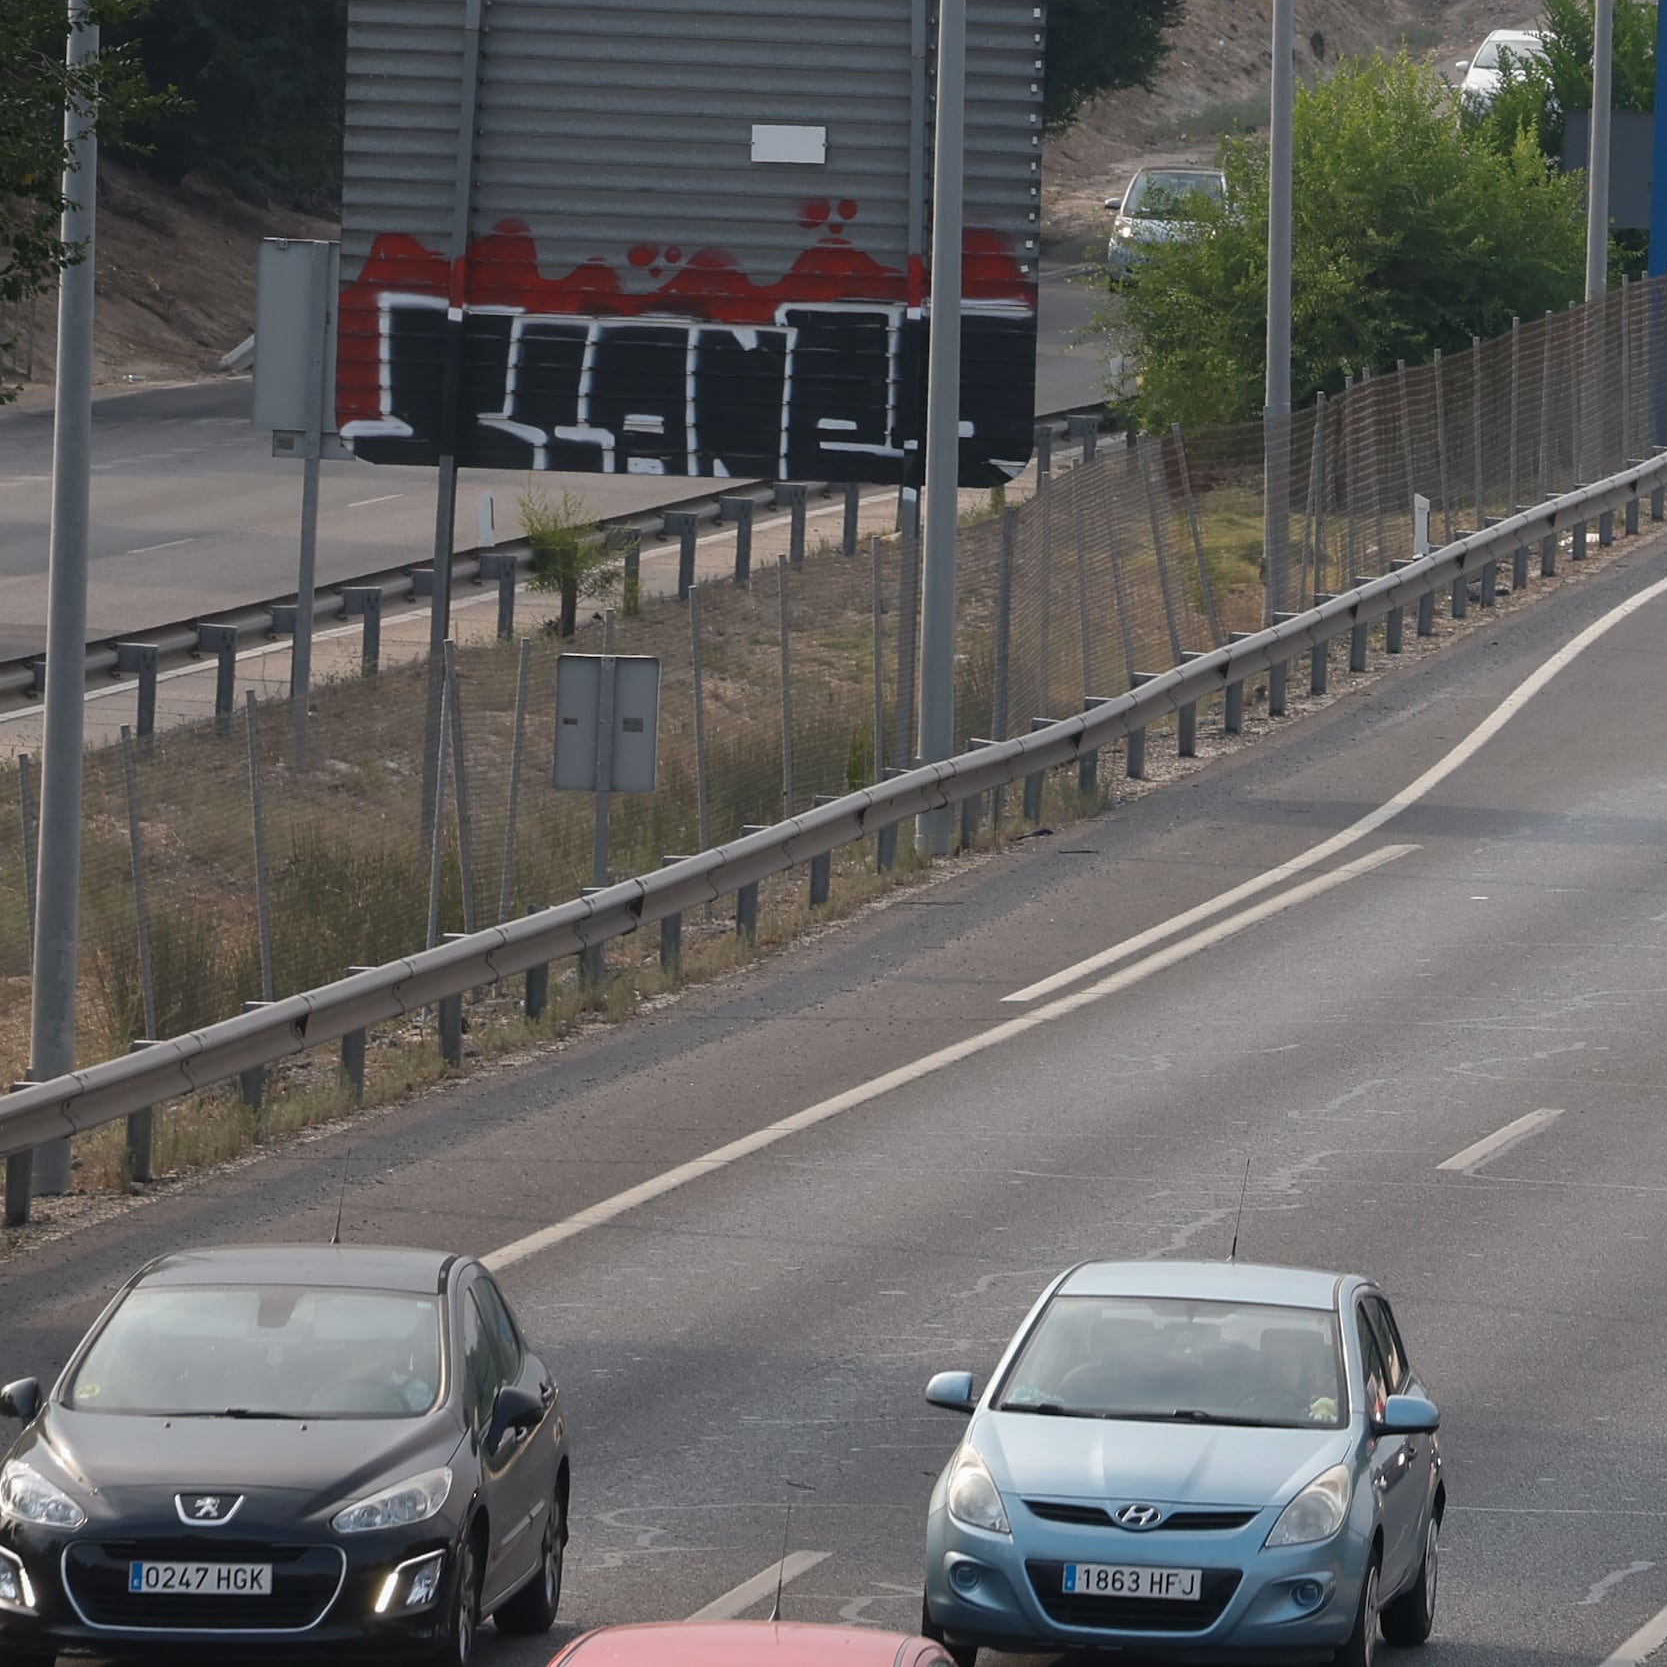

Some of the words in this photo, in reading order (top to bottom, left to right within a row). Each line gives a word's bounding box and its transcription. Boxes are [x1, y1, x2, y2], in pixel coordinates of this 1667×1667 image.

[145, 1566, 209, 1590] 0247
[216, 1567, 264, 1591] HGK
[1083, 1568, 1141, 1593] 1863
[1149, 1571, 1195, 1596] HFJ
